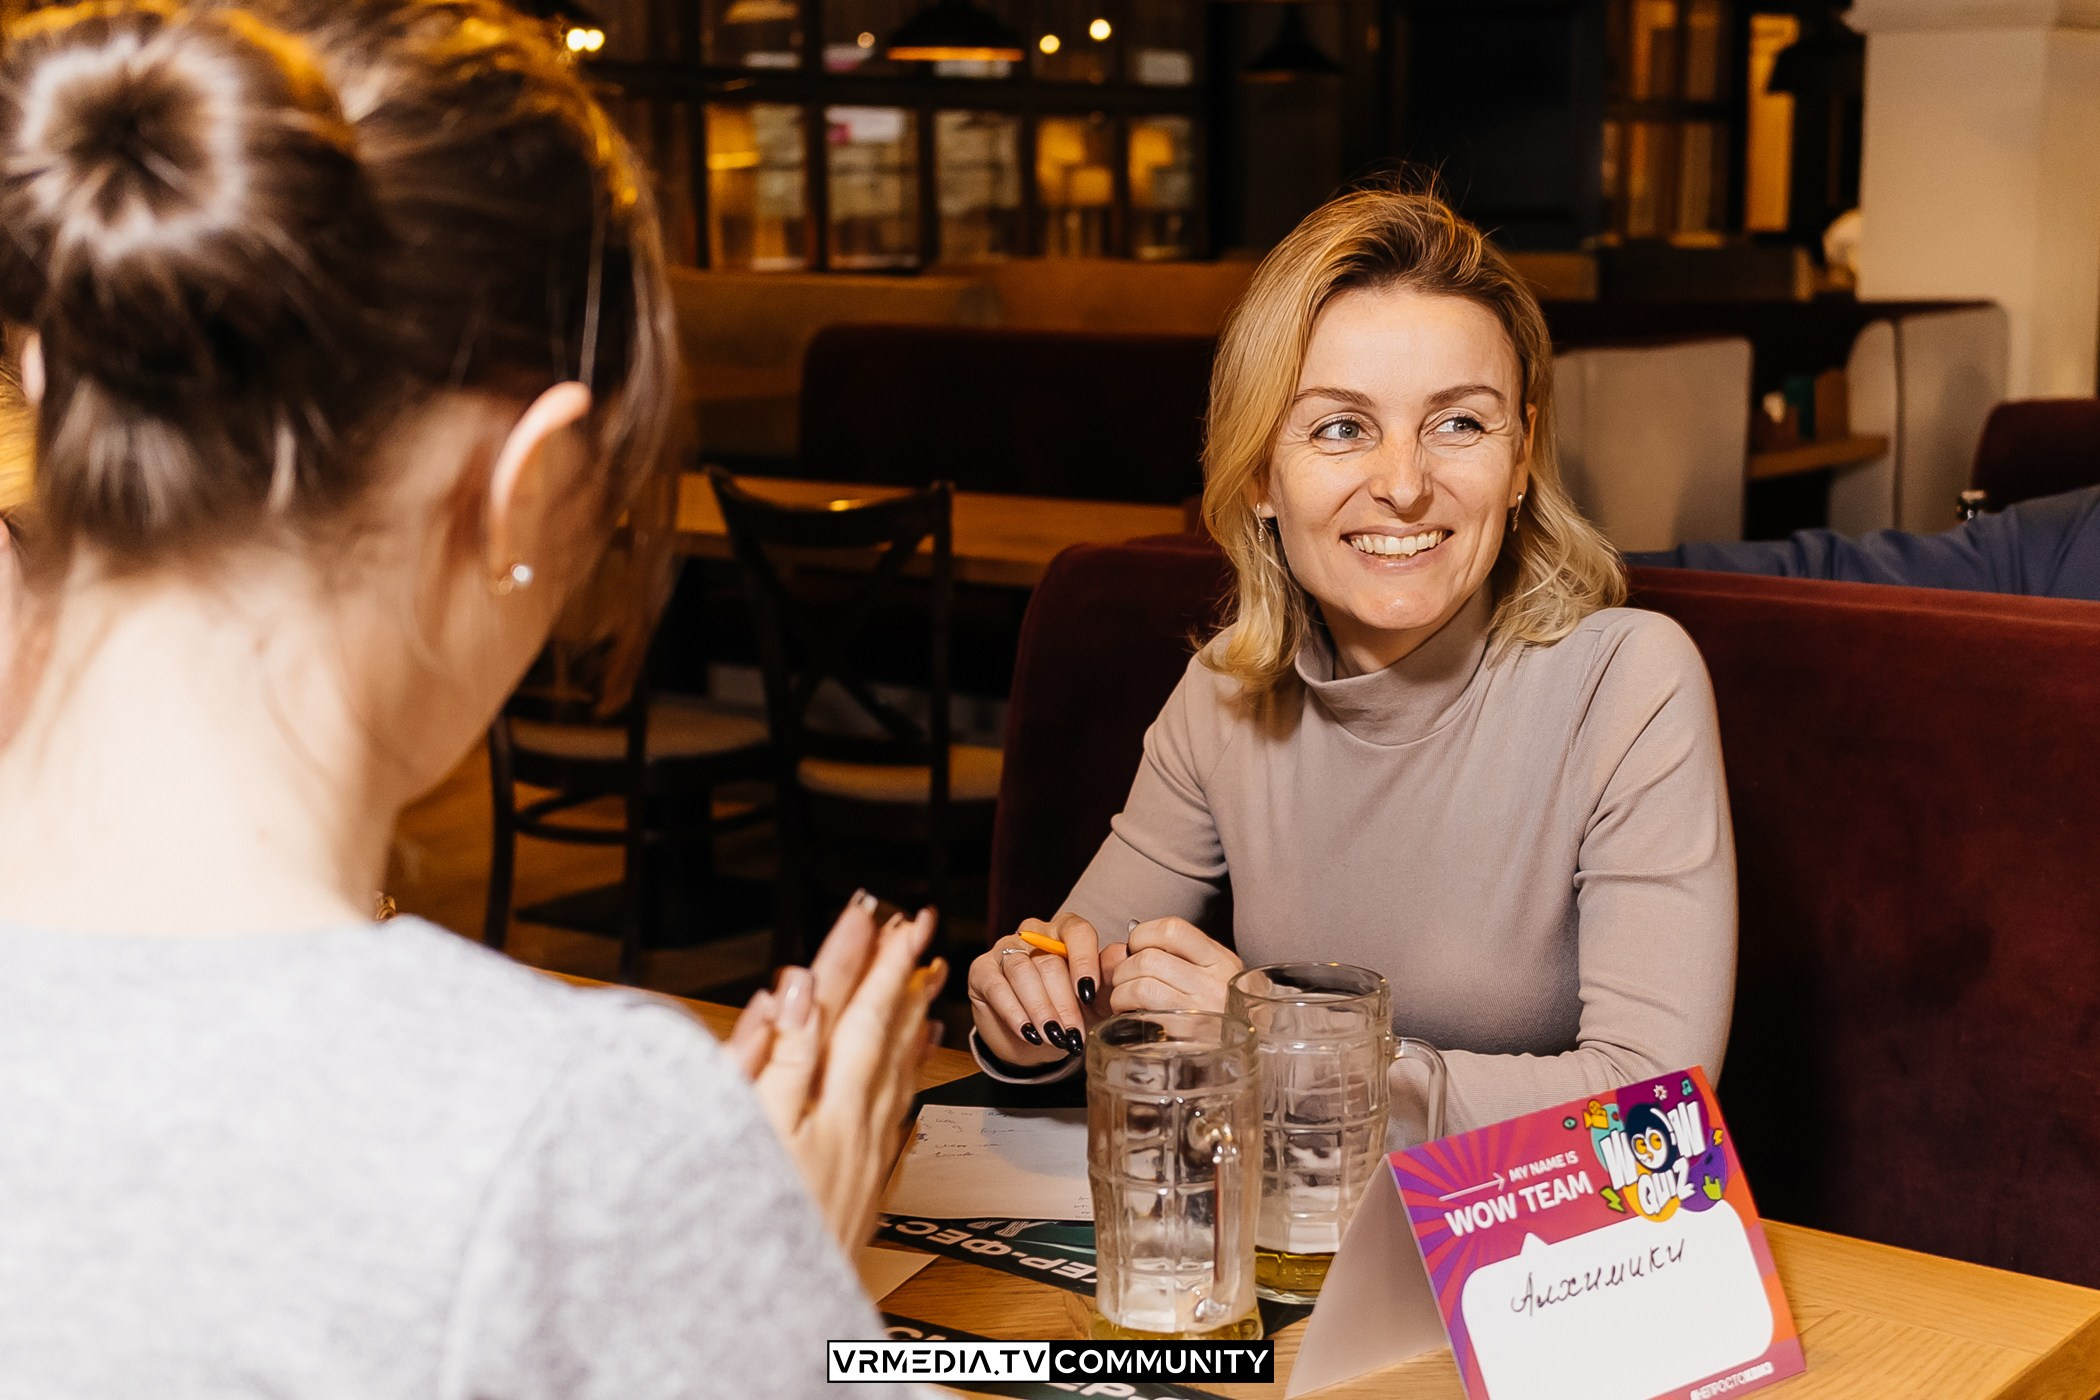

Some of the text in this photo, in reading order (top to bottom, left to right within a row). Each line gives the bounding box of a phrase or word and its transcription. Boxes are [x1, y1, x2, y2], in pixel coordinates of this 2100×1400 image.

[1508, 1150, 1579, 1183] MY NAME IS
[1637, 1156, 1696, 1216] QUIZ
[1444, 1170, 1594, 1238] WOW TEAM
[878, 1219, 1098, 1284] ЕР-ФЕС
